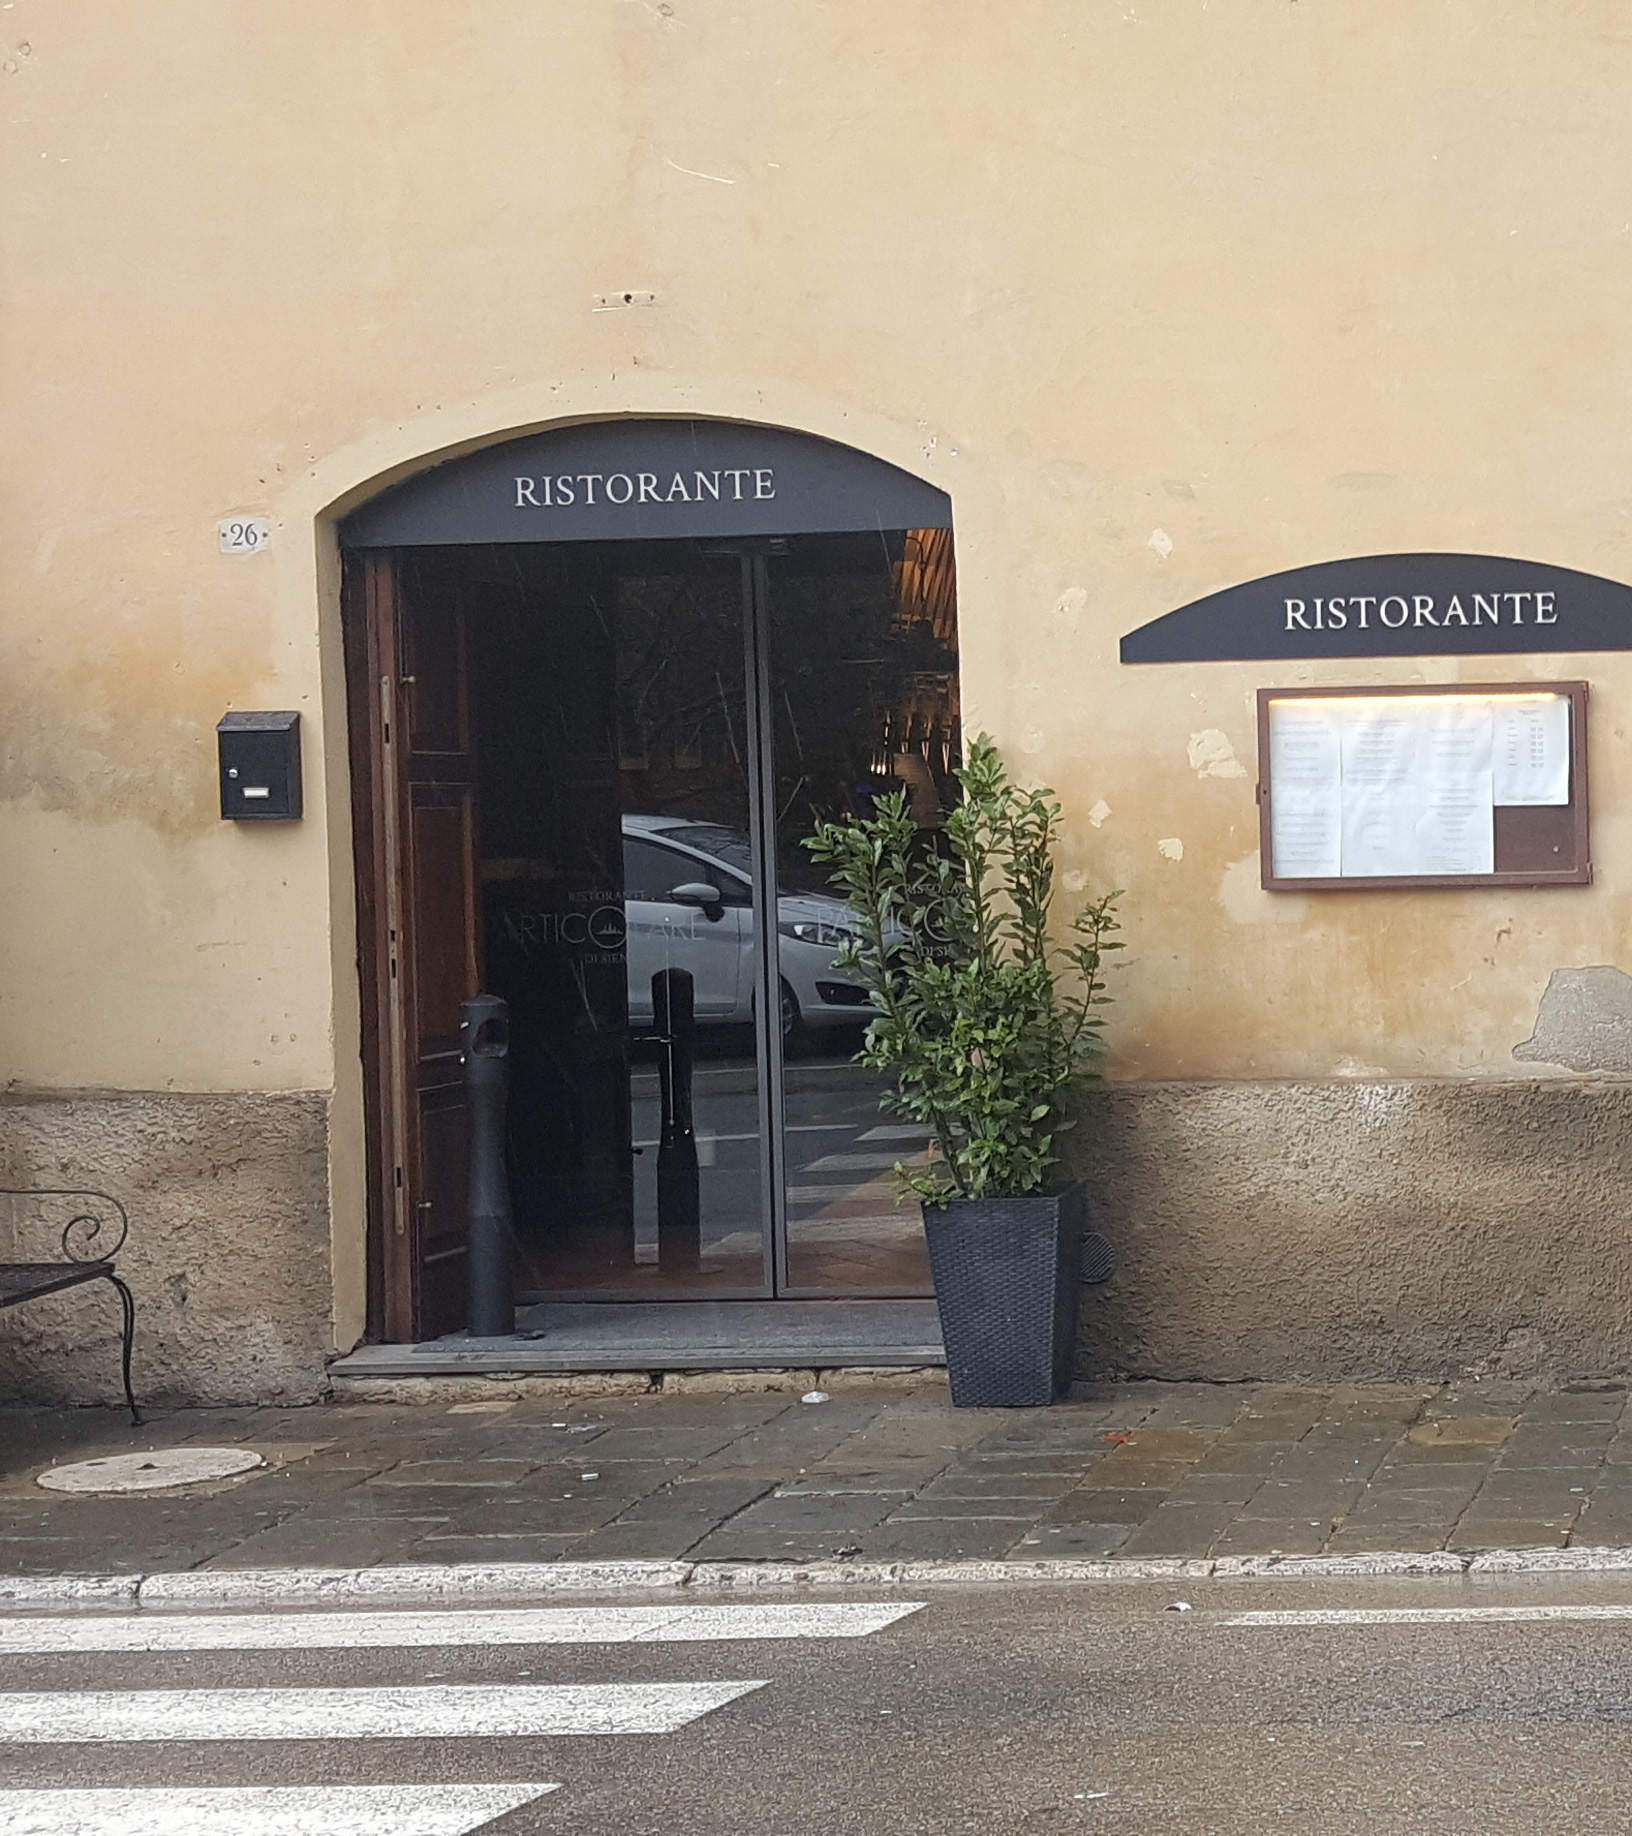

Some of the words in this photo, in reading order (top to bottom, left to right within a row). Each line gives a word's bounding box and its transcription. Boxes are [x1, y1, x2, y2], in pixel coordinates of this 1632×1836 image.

[514, 469, 776, 507] RISTORANTE
[229, 523, 258, 547] 26
[1284, 592, 1558, 630] RISTORANTE
